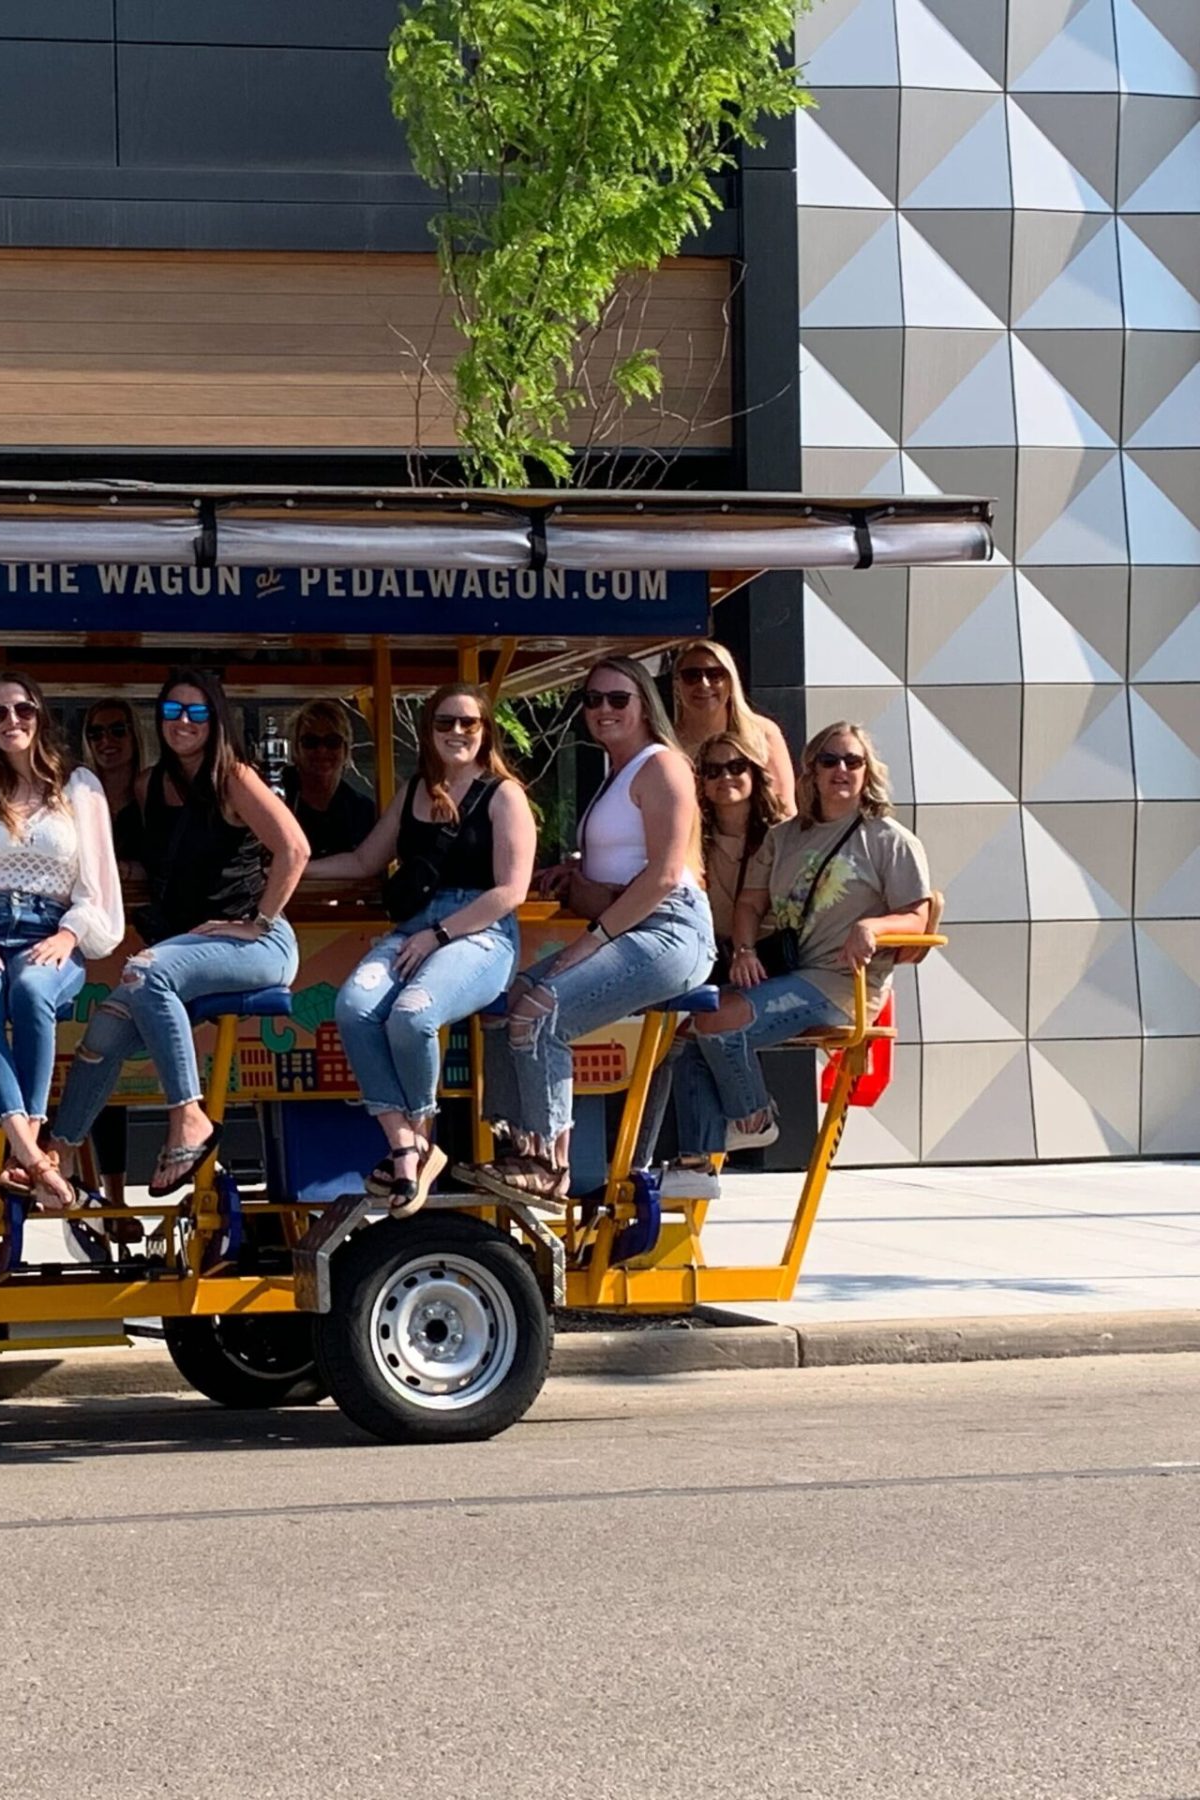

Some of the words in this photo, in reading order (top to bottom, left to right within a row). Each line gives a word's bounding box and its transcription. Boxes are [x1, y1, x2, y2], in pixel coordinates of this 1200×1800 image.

[1, 562, 80, 593] THE
[97, 564, 241, 596] WAGON
[300, 566, 668, 601] PEDALWAGON.COM
